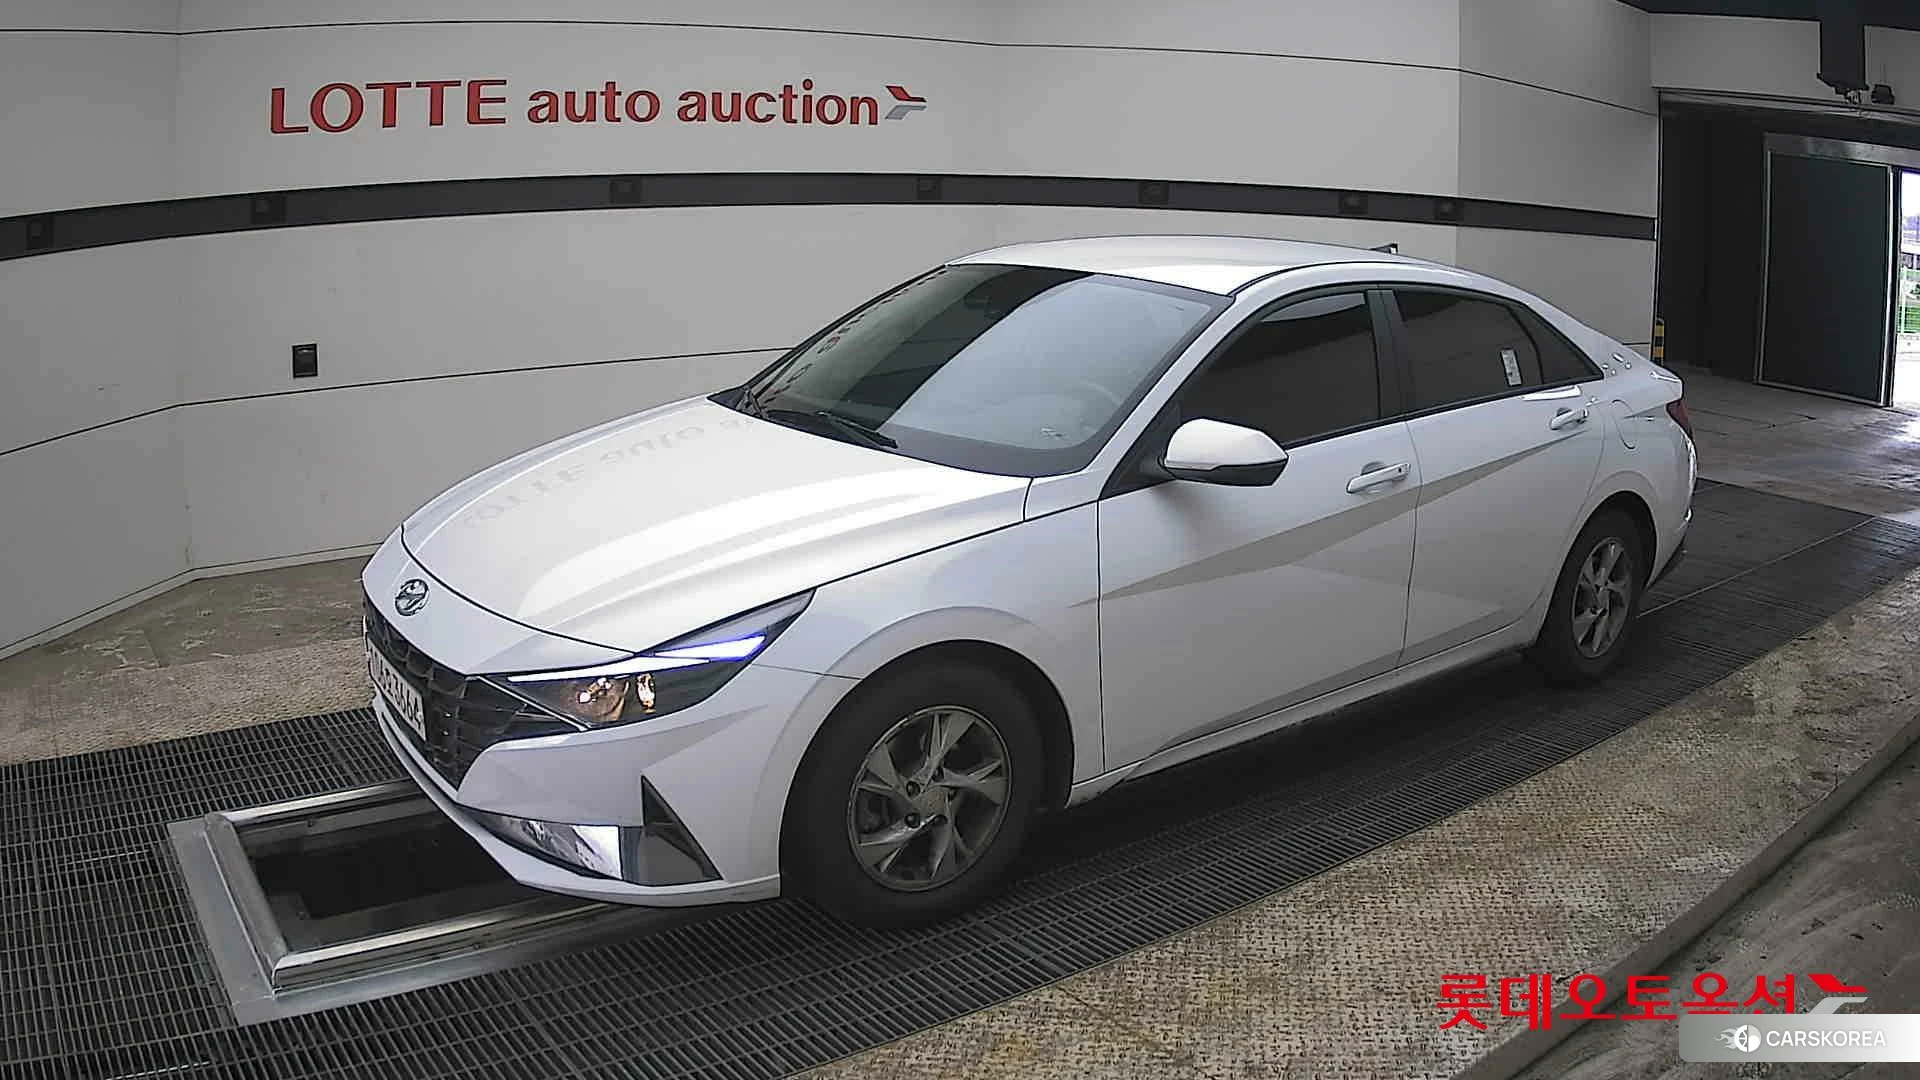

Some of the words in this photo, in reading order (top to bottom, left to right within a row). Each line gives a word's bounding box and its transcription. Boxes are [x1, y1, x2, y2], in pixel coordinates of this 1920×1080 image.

[270, 79, 507, 134] LOTTE
[527, 81, 661, 123] auto
[677, 78, 880, 125] auction
